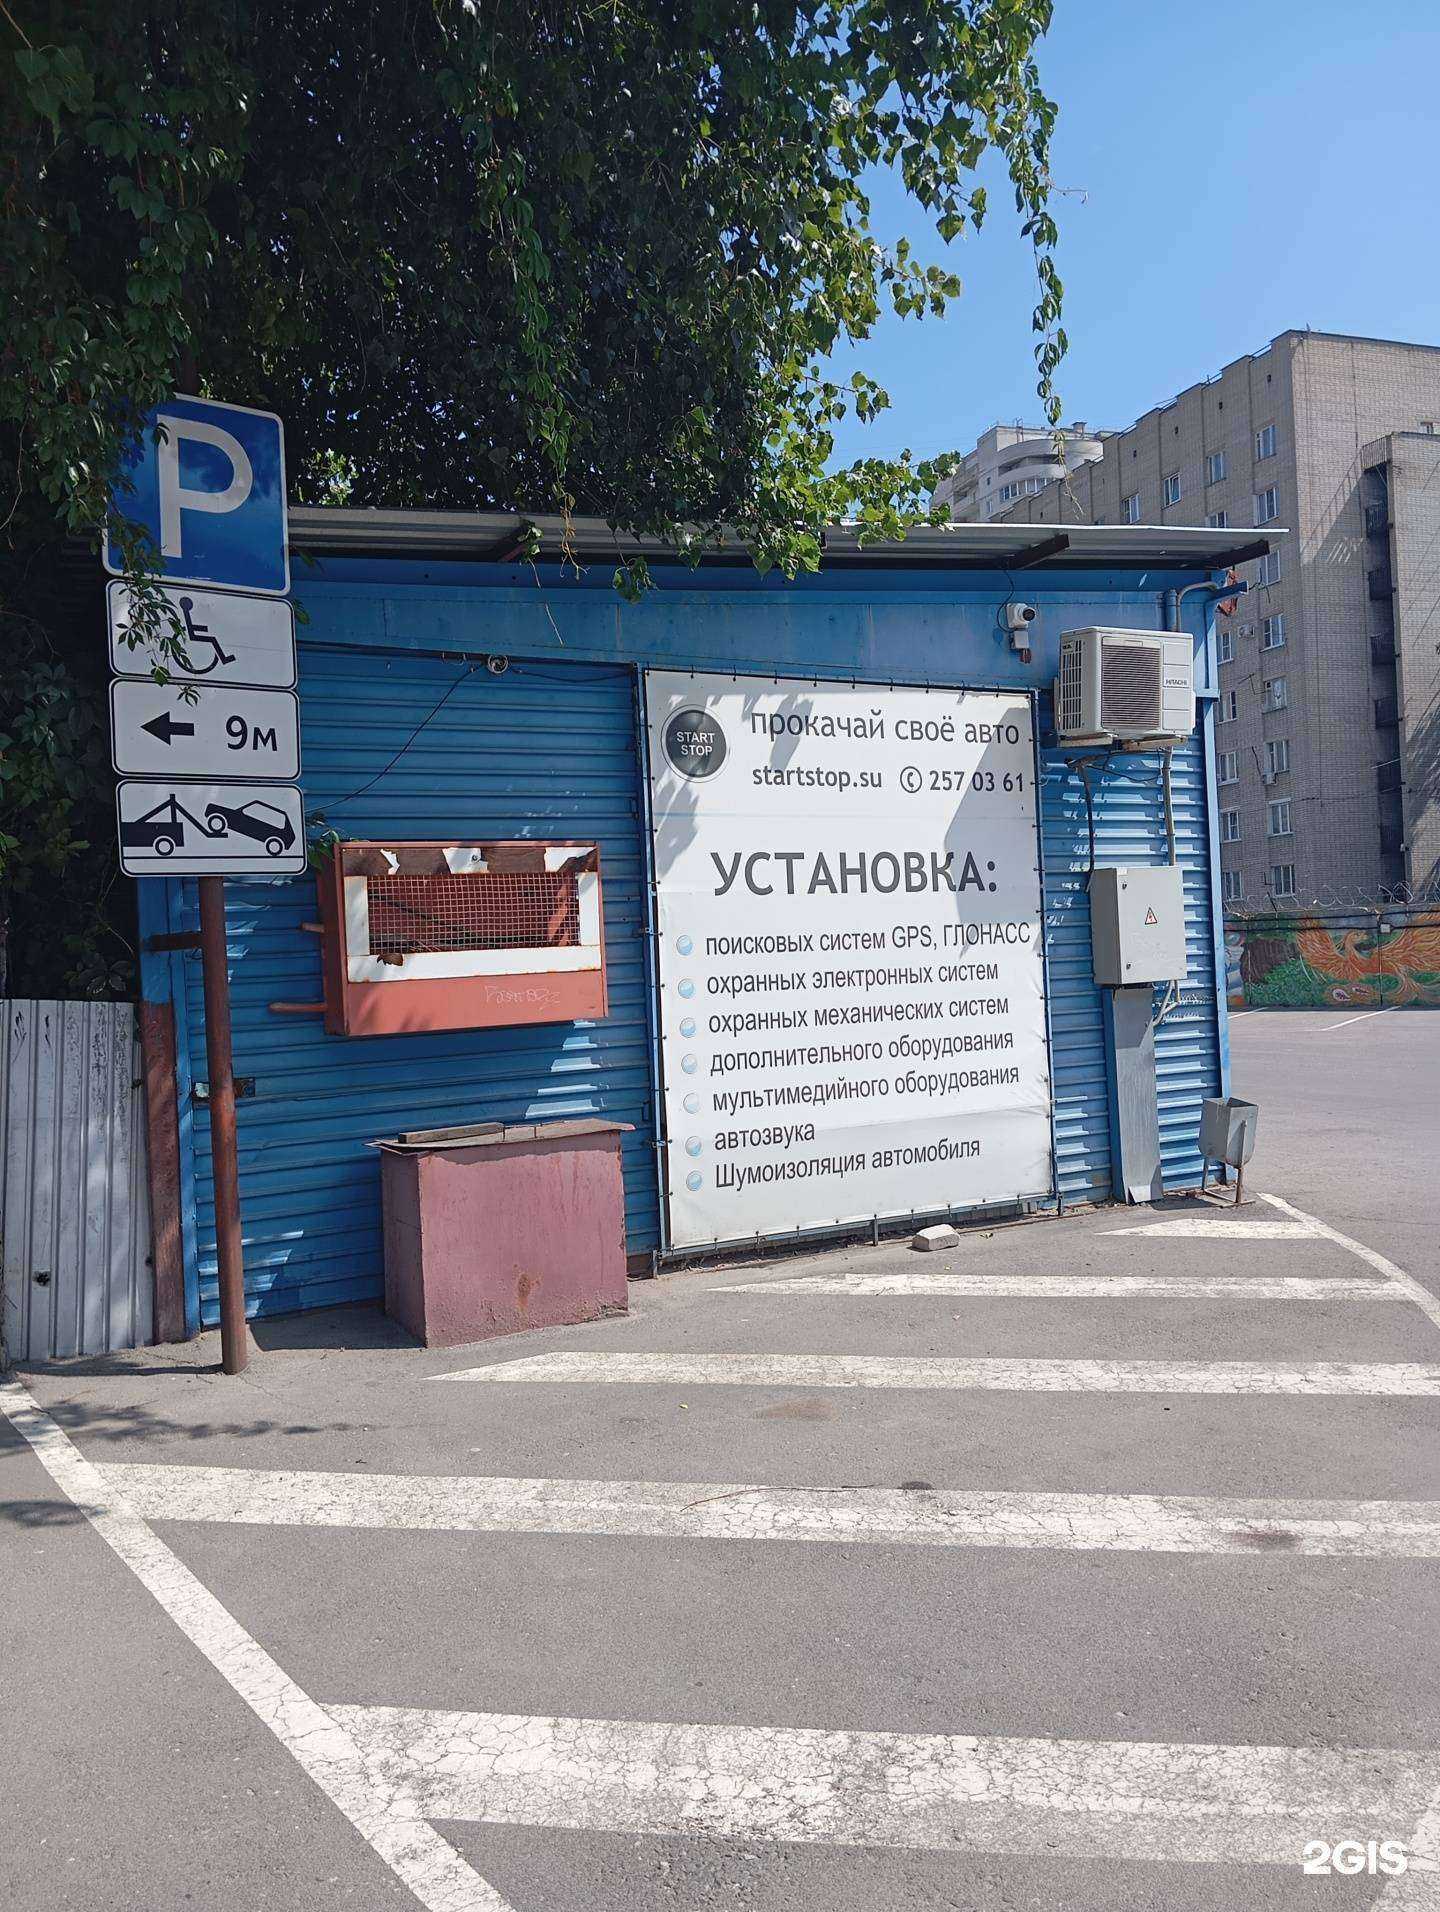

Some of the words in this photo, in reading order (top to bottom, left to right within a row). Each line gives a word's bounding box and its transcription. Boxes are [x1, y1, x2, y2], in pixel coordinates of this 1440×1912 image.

[157, 414, 254, 559] P
[225, 715, 278, 752] 9м
[676, 731, 715, 743] START
[751, 710, 885, 742] прокачай
[895, 715, 956, 742] своё
[964, 723, 1020, 744] авто
[681, 744, 713, 756] STOP
[752, 765, 882, 792] startstop.su
[929, 770, 964, 792] 257
[972, 771, 996, 792] 03
[1003, 773, 1024, 792] 61
[710, 851, 998, 897] УСТАНОВКА:
[706, 929, 813, 955] поисковых
[819, 928, 885, 951] систем
[891, 925, 938, 950] GPS,
[942, 921, 1030, 946] ГЛОНАСС
[706, 969, 807, 998] охранных
[812, 962, 933, 993] электронных
[938, 960, 998, 982] систем
[708, 1007, 808, 1037] охранных
[814, 999, 943, 1027] механических
[948, 995, 1009, 1017] систем
[710, 1039, 883, 1077] дополнительного
[888, 1030, 1014, 1059] оборудования
[712, 1076, 889, 1117] мультимедийного
[895, 1064, 1020, 1096] оборудования
[714, 1120, 815, 1151] автозвука
[715, 1151, 866, 1191] Шумоизоляция
[872, 1137, 981, 1170] автомобиля
